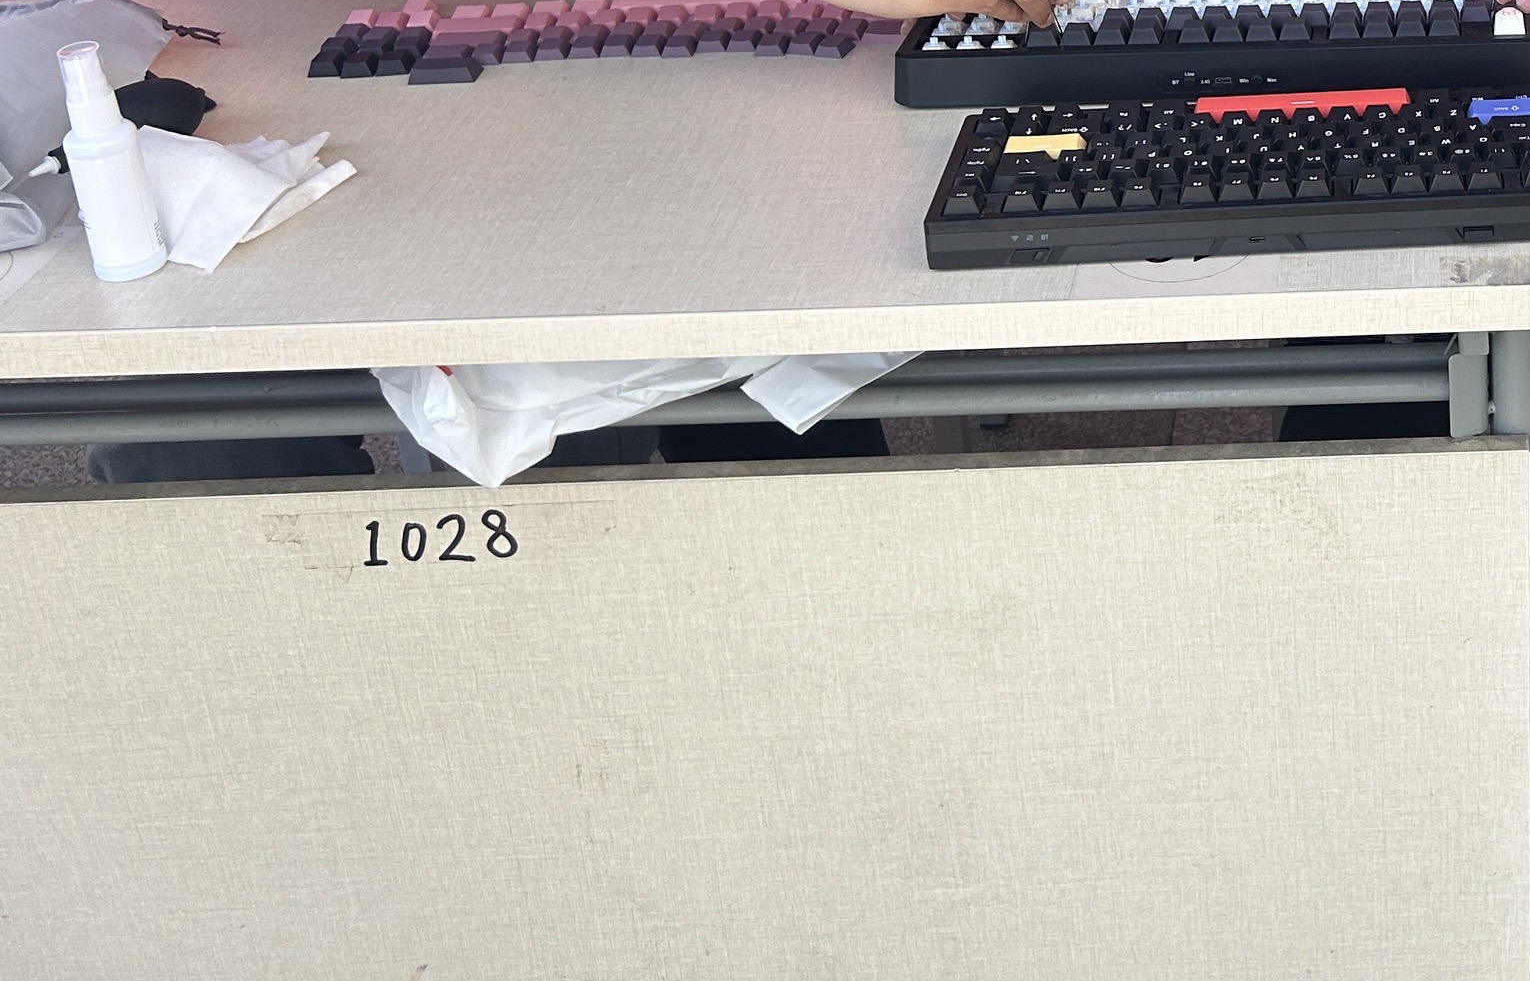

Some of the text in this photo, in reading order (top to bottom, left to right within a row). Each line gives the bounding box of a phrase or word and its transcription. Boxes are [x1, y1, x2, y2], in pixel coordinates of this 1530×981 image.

[1450, 109, 1457, 117] Z
[1233, 118, 1243, 126] M
[1271, 117, 1280, 125] N
[363, 509, 519, 567] 1028
